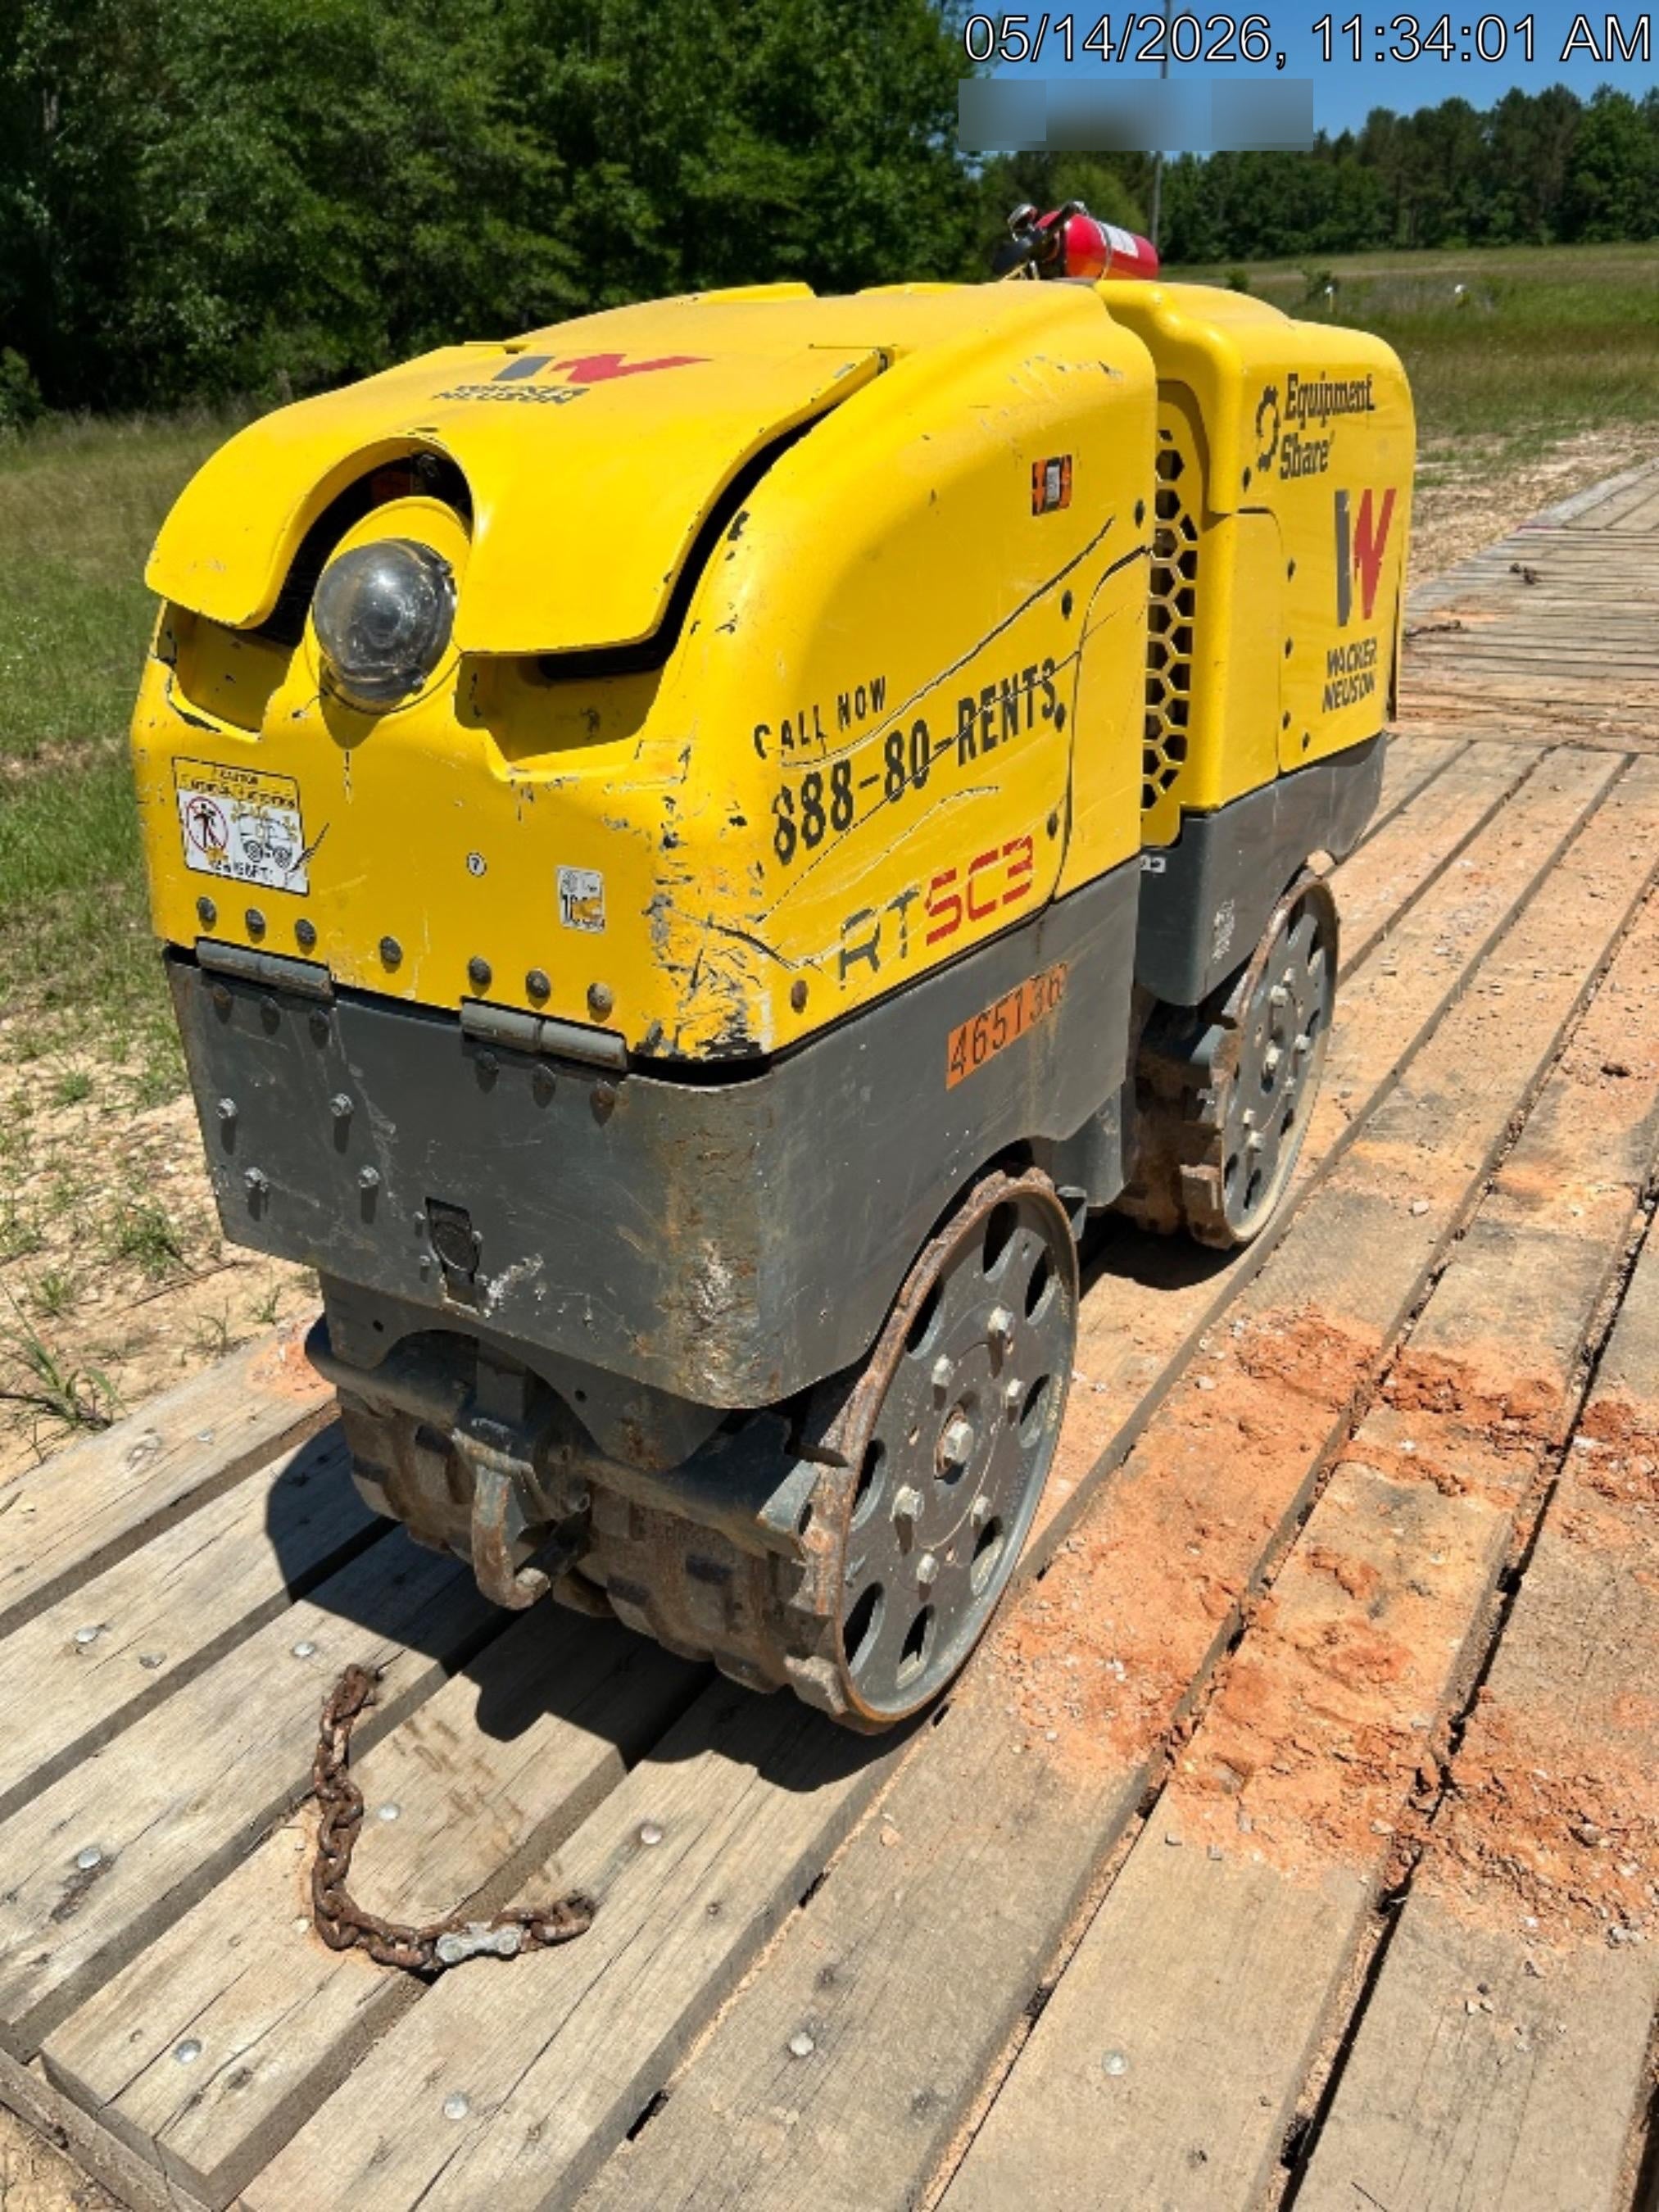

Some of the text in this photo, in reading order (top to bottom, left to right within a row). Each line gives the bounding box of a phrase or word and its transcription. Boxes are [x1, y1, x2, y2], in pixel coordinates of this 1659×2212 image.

[1284, 370, 1375, 430] Equipment
[1280, 432, 1329, 480] Share
[1326, 636, 1377, 678] WACKER
[754, 675, 886, 759] CALL NOW
[1321, 671, 1375, 714] NEUSON
[772, 657, 1057, 867] 888-80-RENTS
